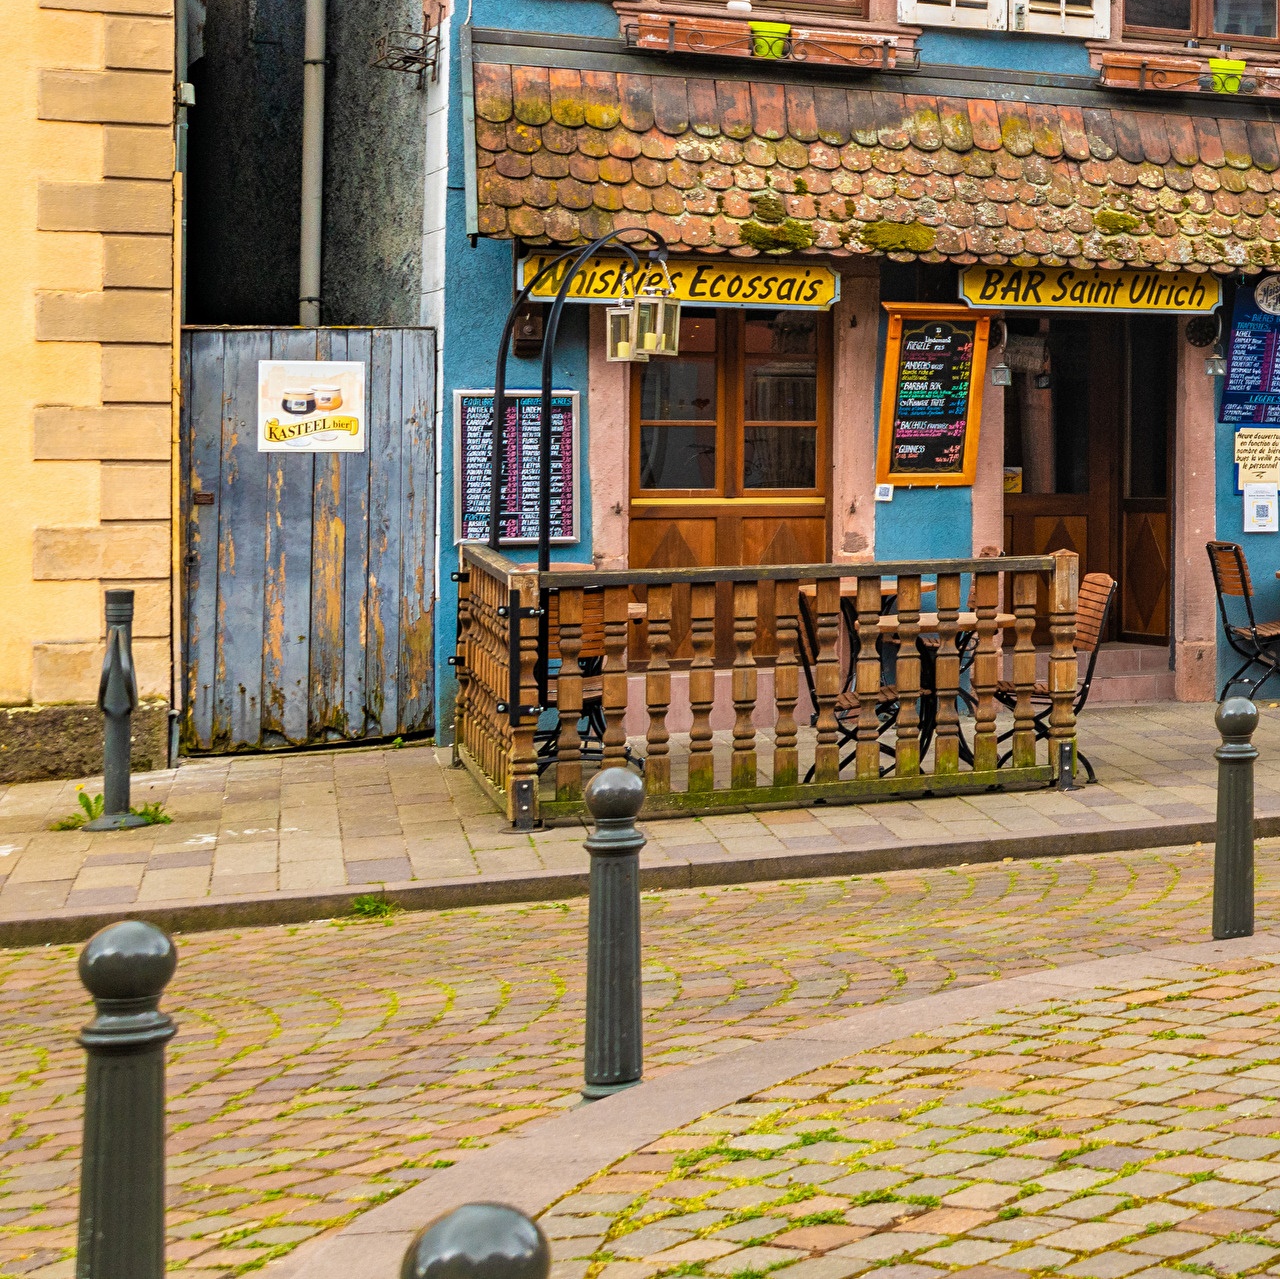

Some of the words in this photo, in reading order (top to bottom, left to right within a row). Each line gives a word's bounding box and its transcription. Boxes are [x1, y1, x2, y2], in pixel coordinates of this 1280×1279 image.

[688, 264, 824, 302] Ecossais
[979, 269, 1046, 304] BAR
[1051, 271, 1124, 305] Saint
[1129, 274, 1206, 307] Ulrich
[269, 418, 331, 441] KASTEEL
[333, 419, 350, 429] bier
[898, 444, 926, 453] GUINNESS
[1236, 454, 1250, 462] bues
[1248, 462, 1278, 470] personnel
